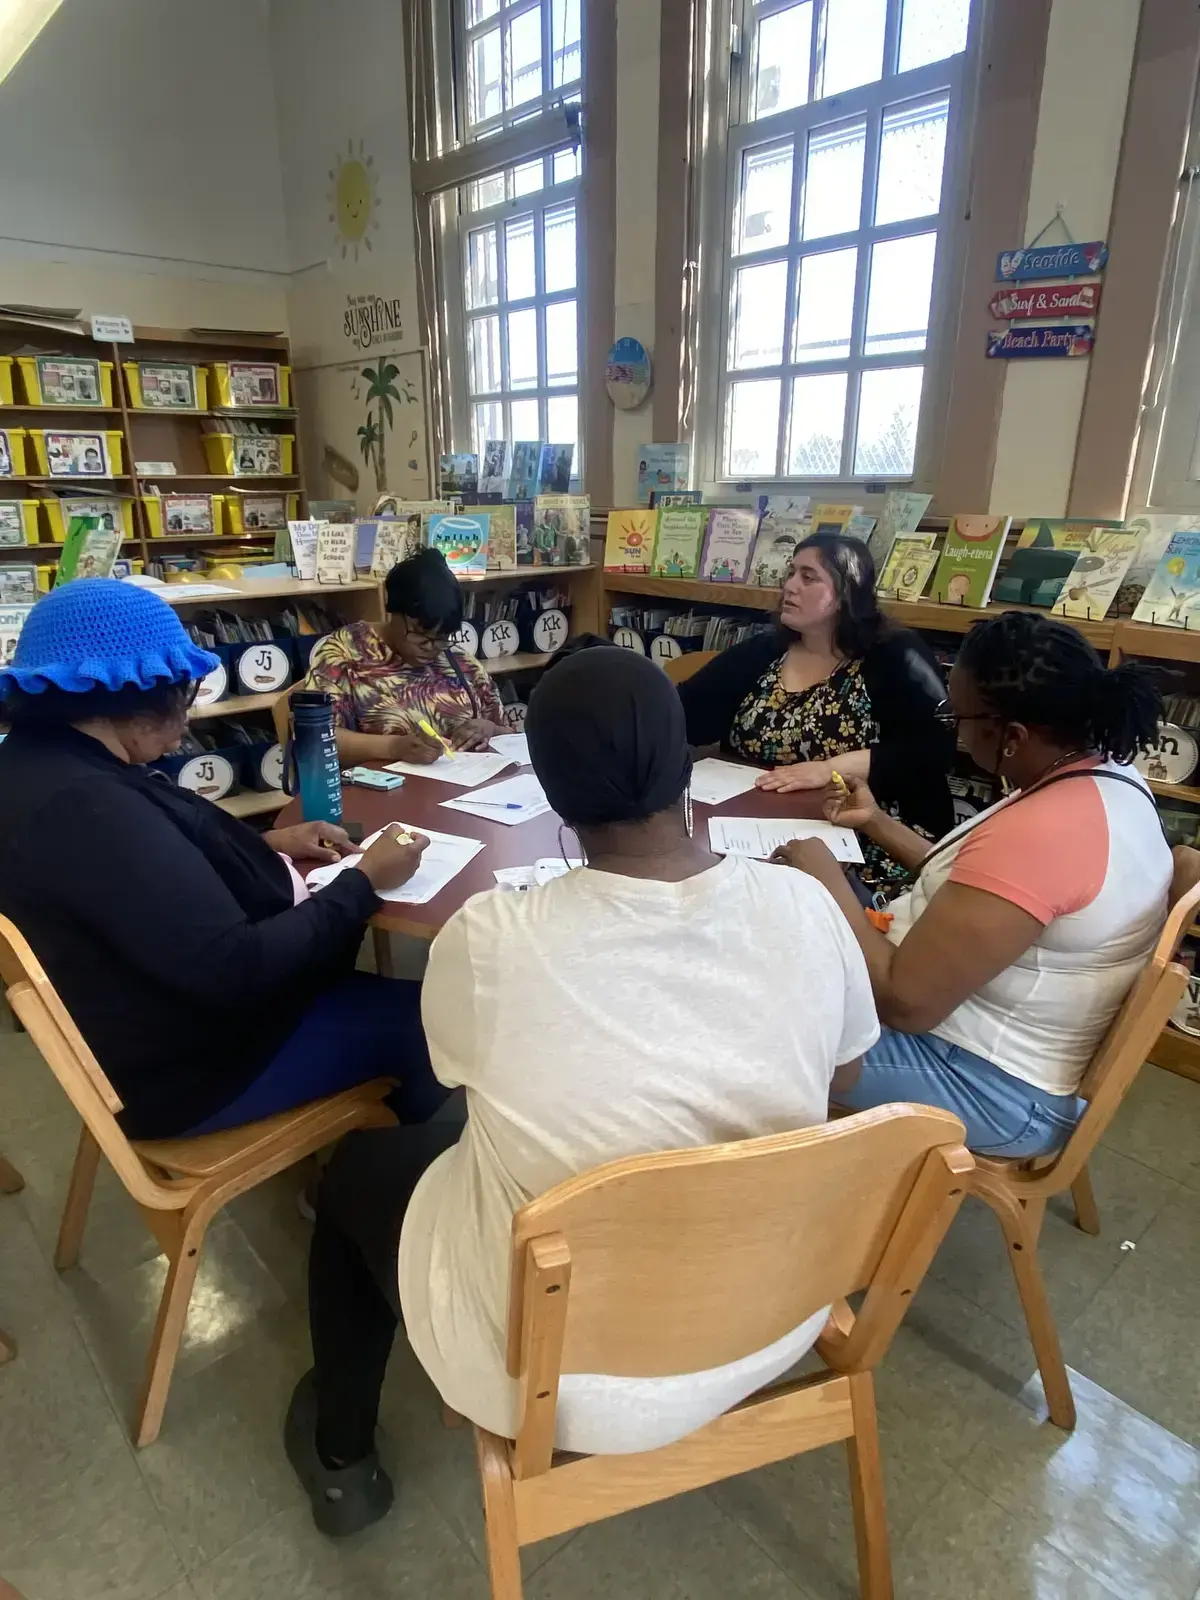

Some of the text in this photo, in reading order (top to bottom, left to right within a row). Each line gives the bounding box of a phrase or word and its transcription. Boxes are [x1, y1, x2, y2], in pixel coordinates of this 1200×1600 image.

[1024, 248, 1080, 270] Seaside
[1009, 291, 1082, 316] Surf & Sand
[343, 297, 402, 348] SUNSHINE
[1002, 330, 1077, 351] Beach Party
[436, 533, 479, 542] Splish
[624, 547, 641, 555] SUN
[945, 544, 994, 562] Laugh-eteria
[255, 650, 272, 671] Jj
[195, 761, 215, 781] Jj
